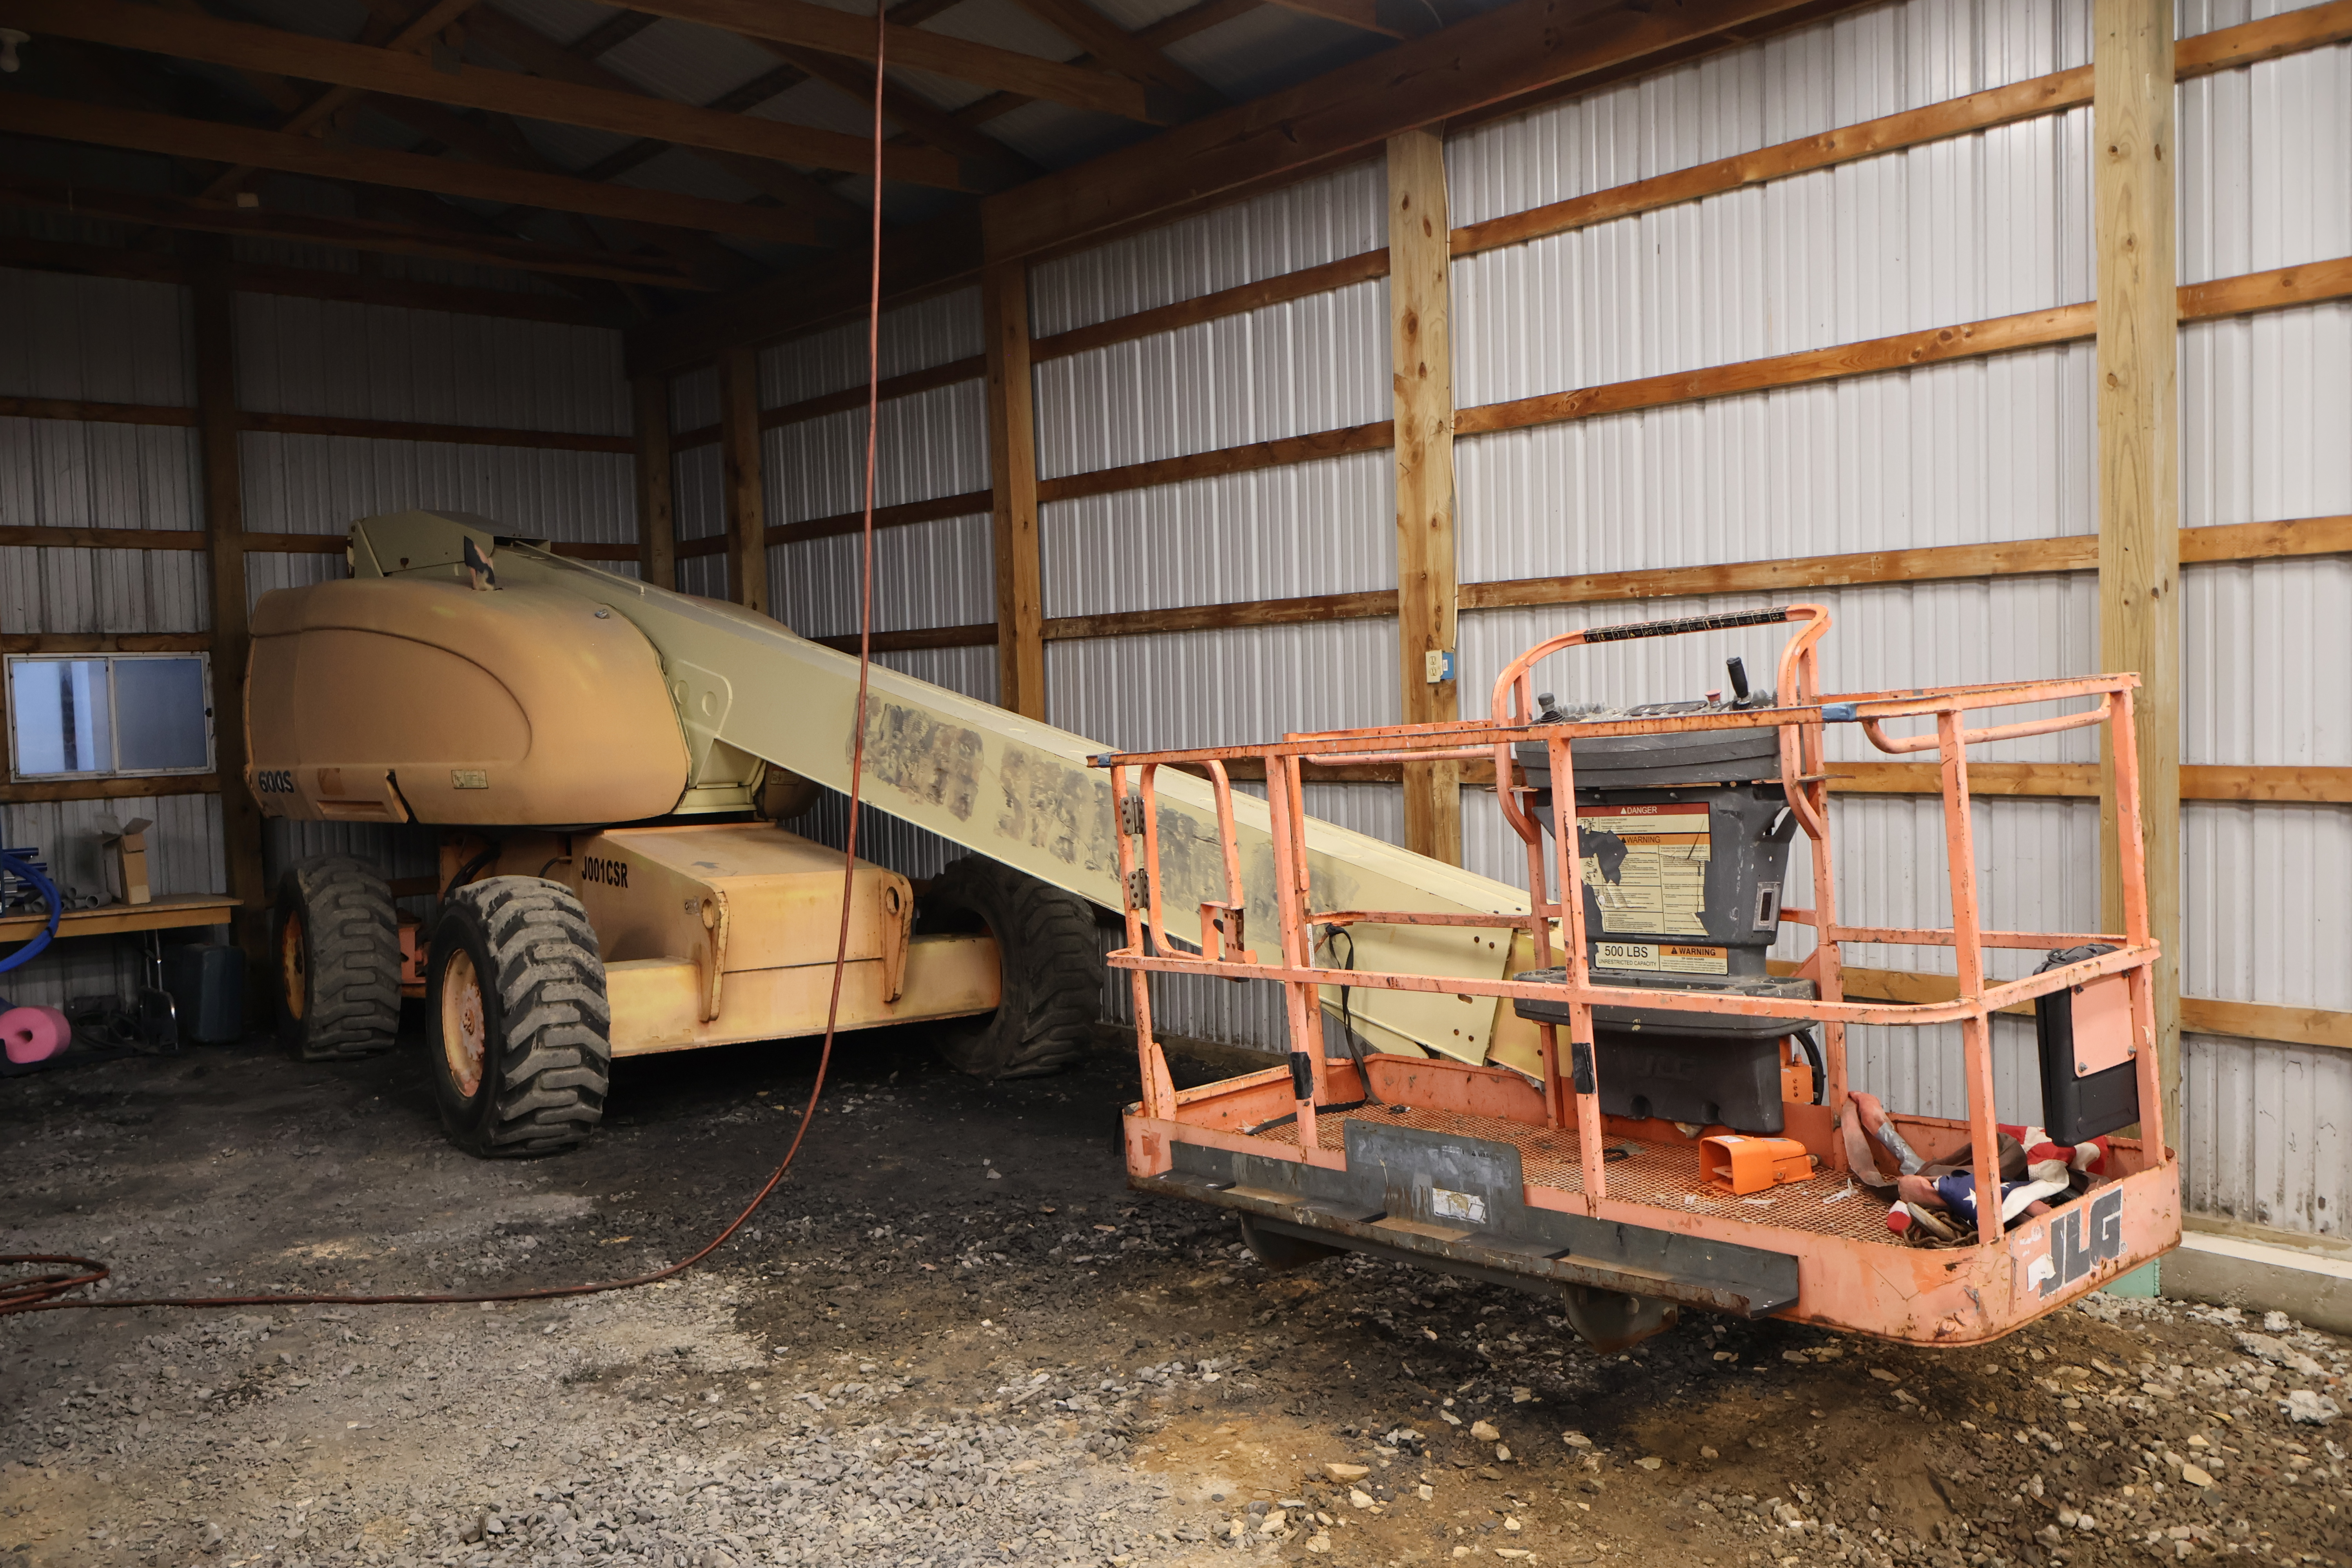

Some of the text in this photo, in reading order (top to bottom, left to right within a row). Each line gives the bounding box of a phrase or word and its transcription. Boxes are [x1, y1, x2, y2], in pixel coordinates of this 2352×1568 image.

[258, 771, 294, 793] 600S
[582, 856, 628, 888] J001CSR
[1604, 946, 1648, 958] 500 LBS
[1679, 947, 1715, 956] WARNING
[2038, 1185, 2123, 1301] JLG
